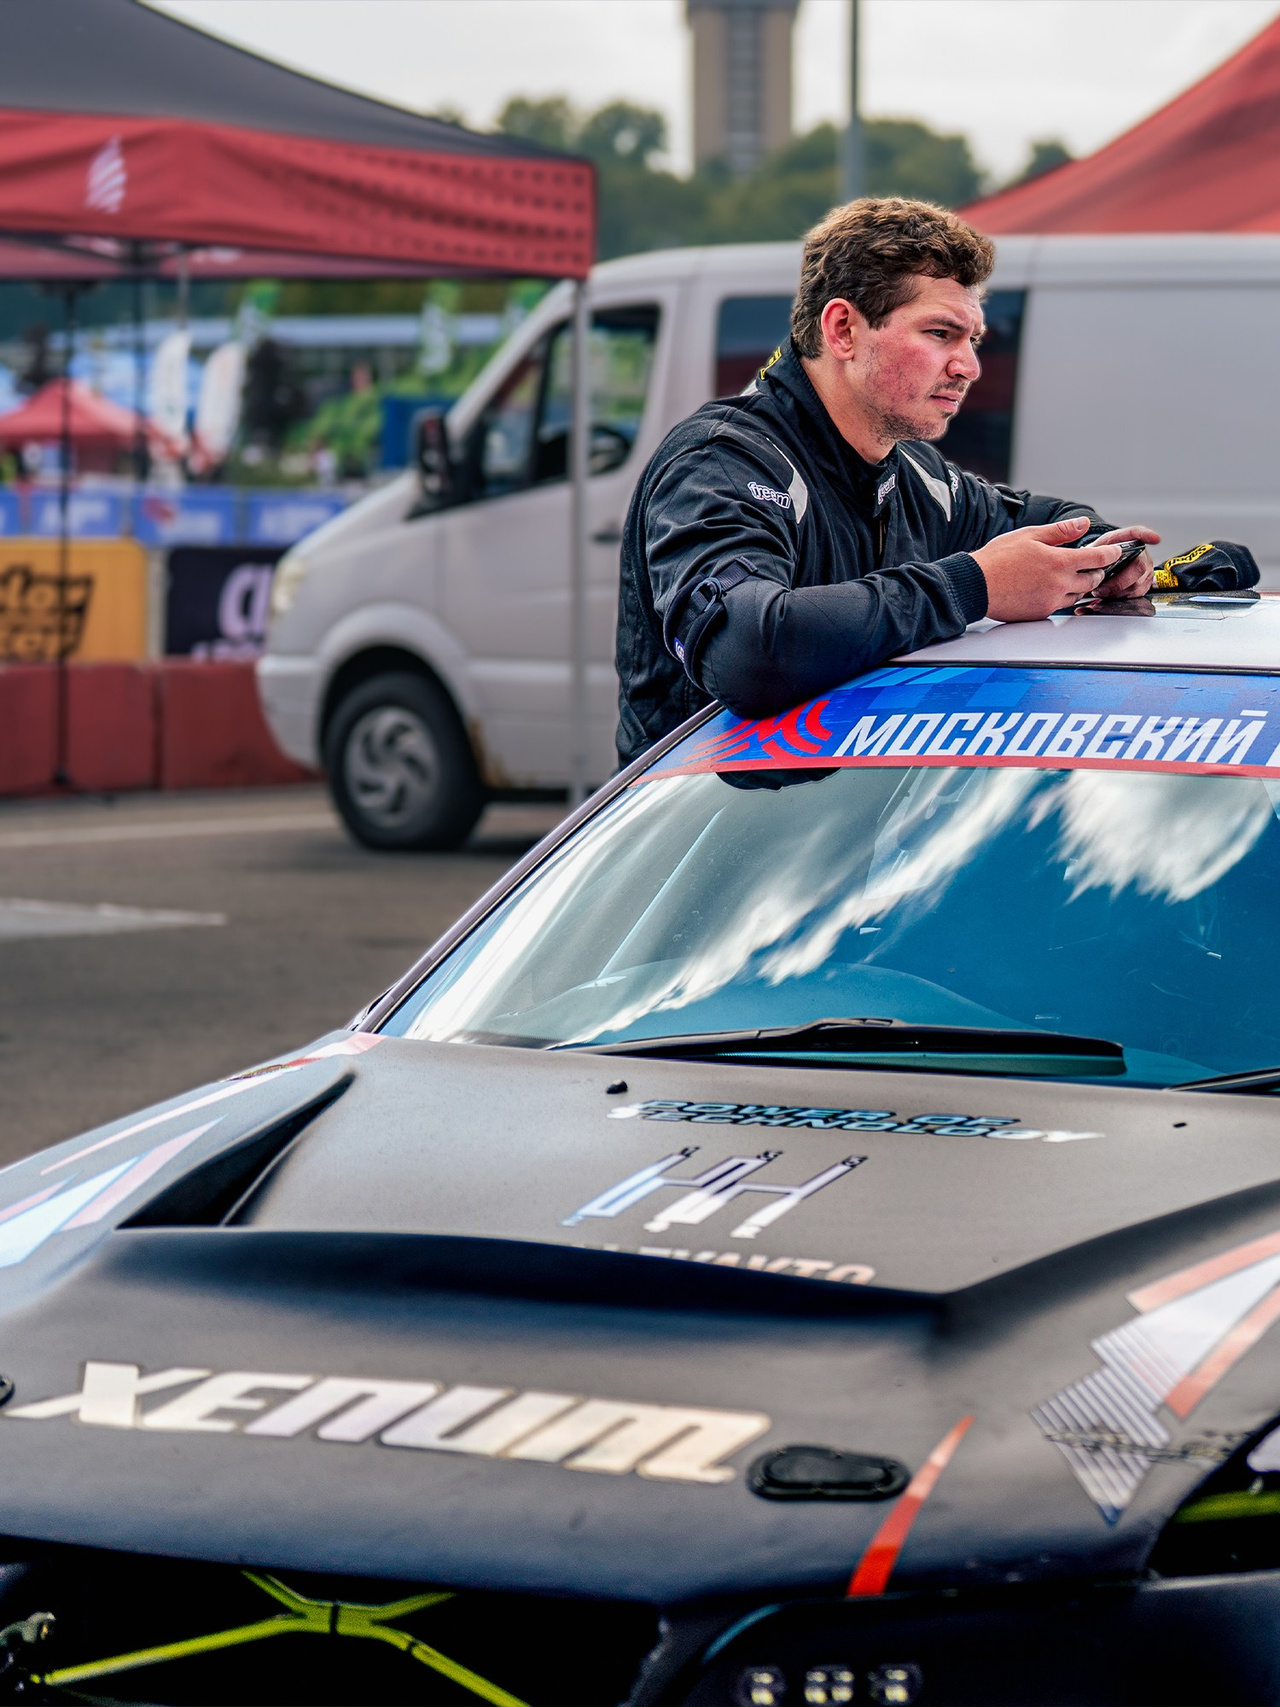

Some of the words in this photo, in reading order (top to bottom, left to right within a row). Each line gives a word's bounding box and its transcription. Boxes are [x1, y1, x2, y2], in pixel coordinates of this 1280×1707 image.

[747, 480, 792, 509] freem
[832, 709, 1267, 765] МОСКОВСКИЙ
[606, 1103, 1107, 1143] TECHNOLOGY
[638, 1099, 897, 1122] POWER
[906, 1112, 1022, 1127] OF
[4, 1361, 771, 1485] XENUM
